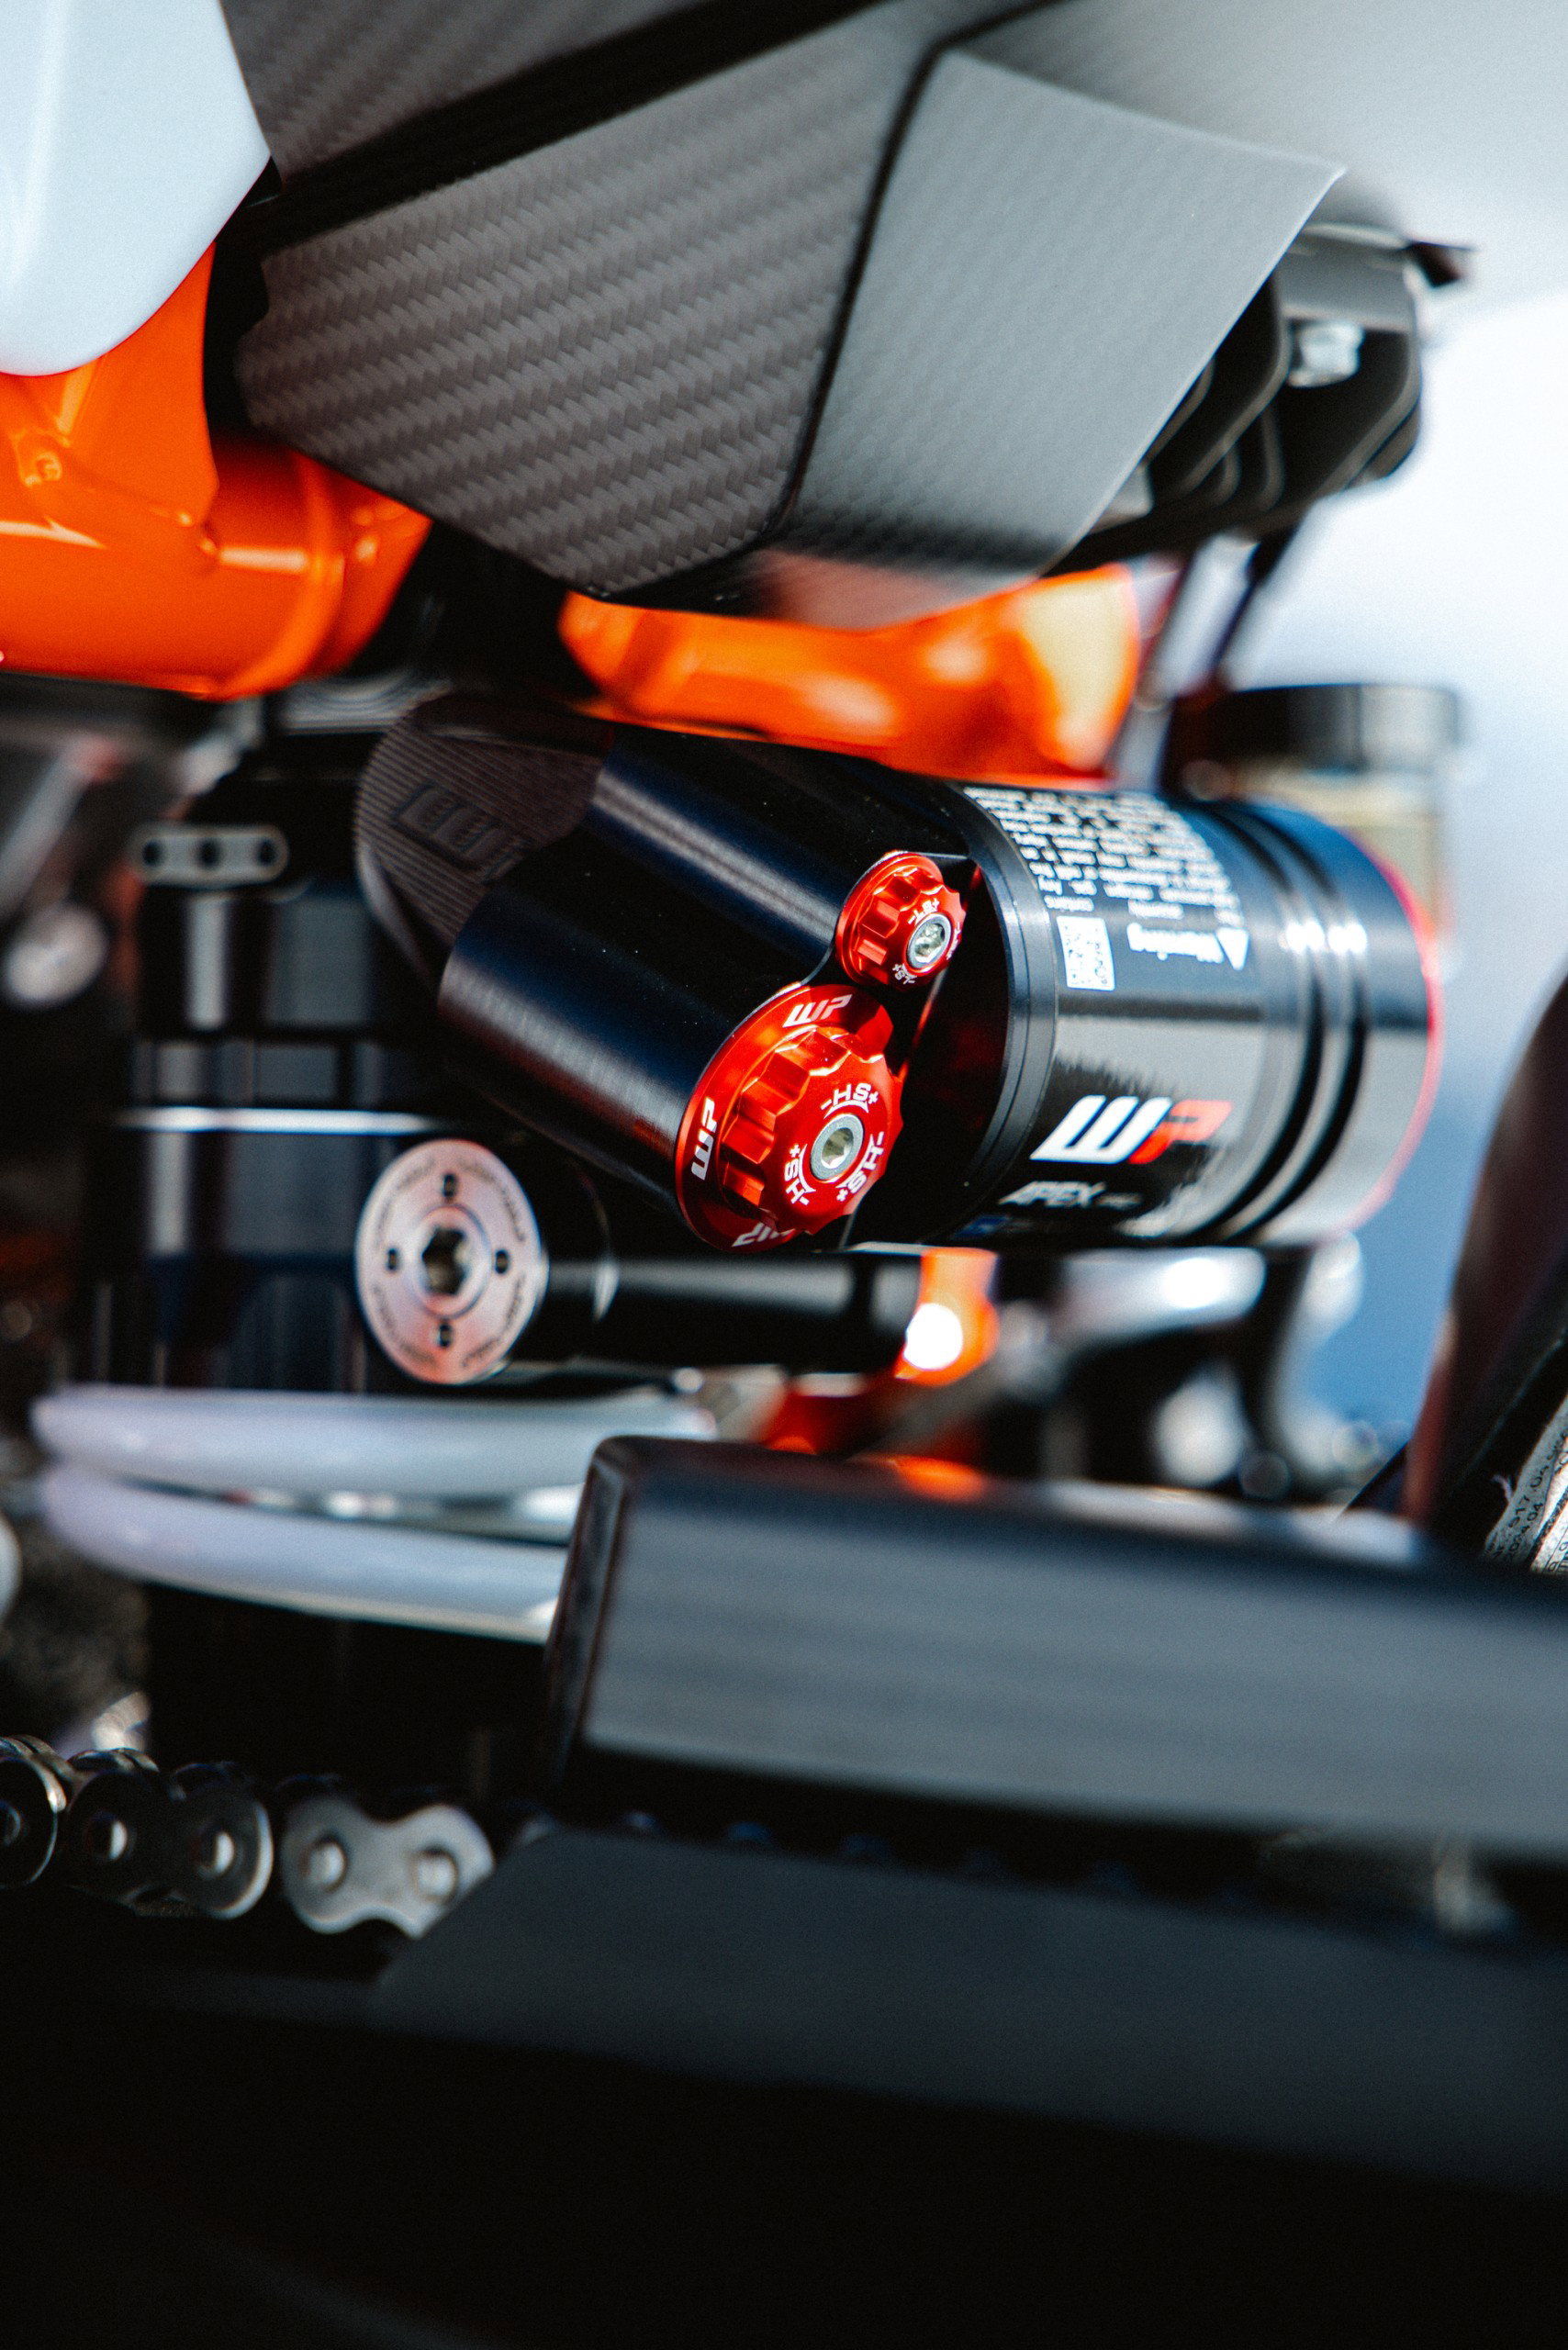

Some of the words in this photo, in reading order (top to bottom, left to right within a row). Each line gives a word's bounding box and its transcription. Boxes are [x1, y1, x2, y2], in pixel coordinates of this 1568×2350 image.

[782, 994, 853, 1028] WP
[690, 1096, 718, 1181] WP
[1029, 1094, 1233, 1165] WP
[998, 1181, 1106, 1207] APEX
